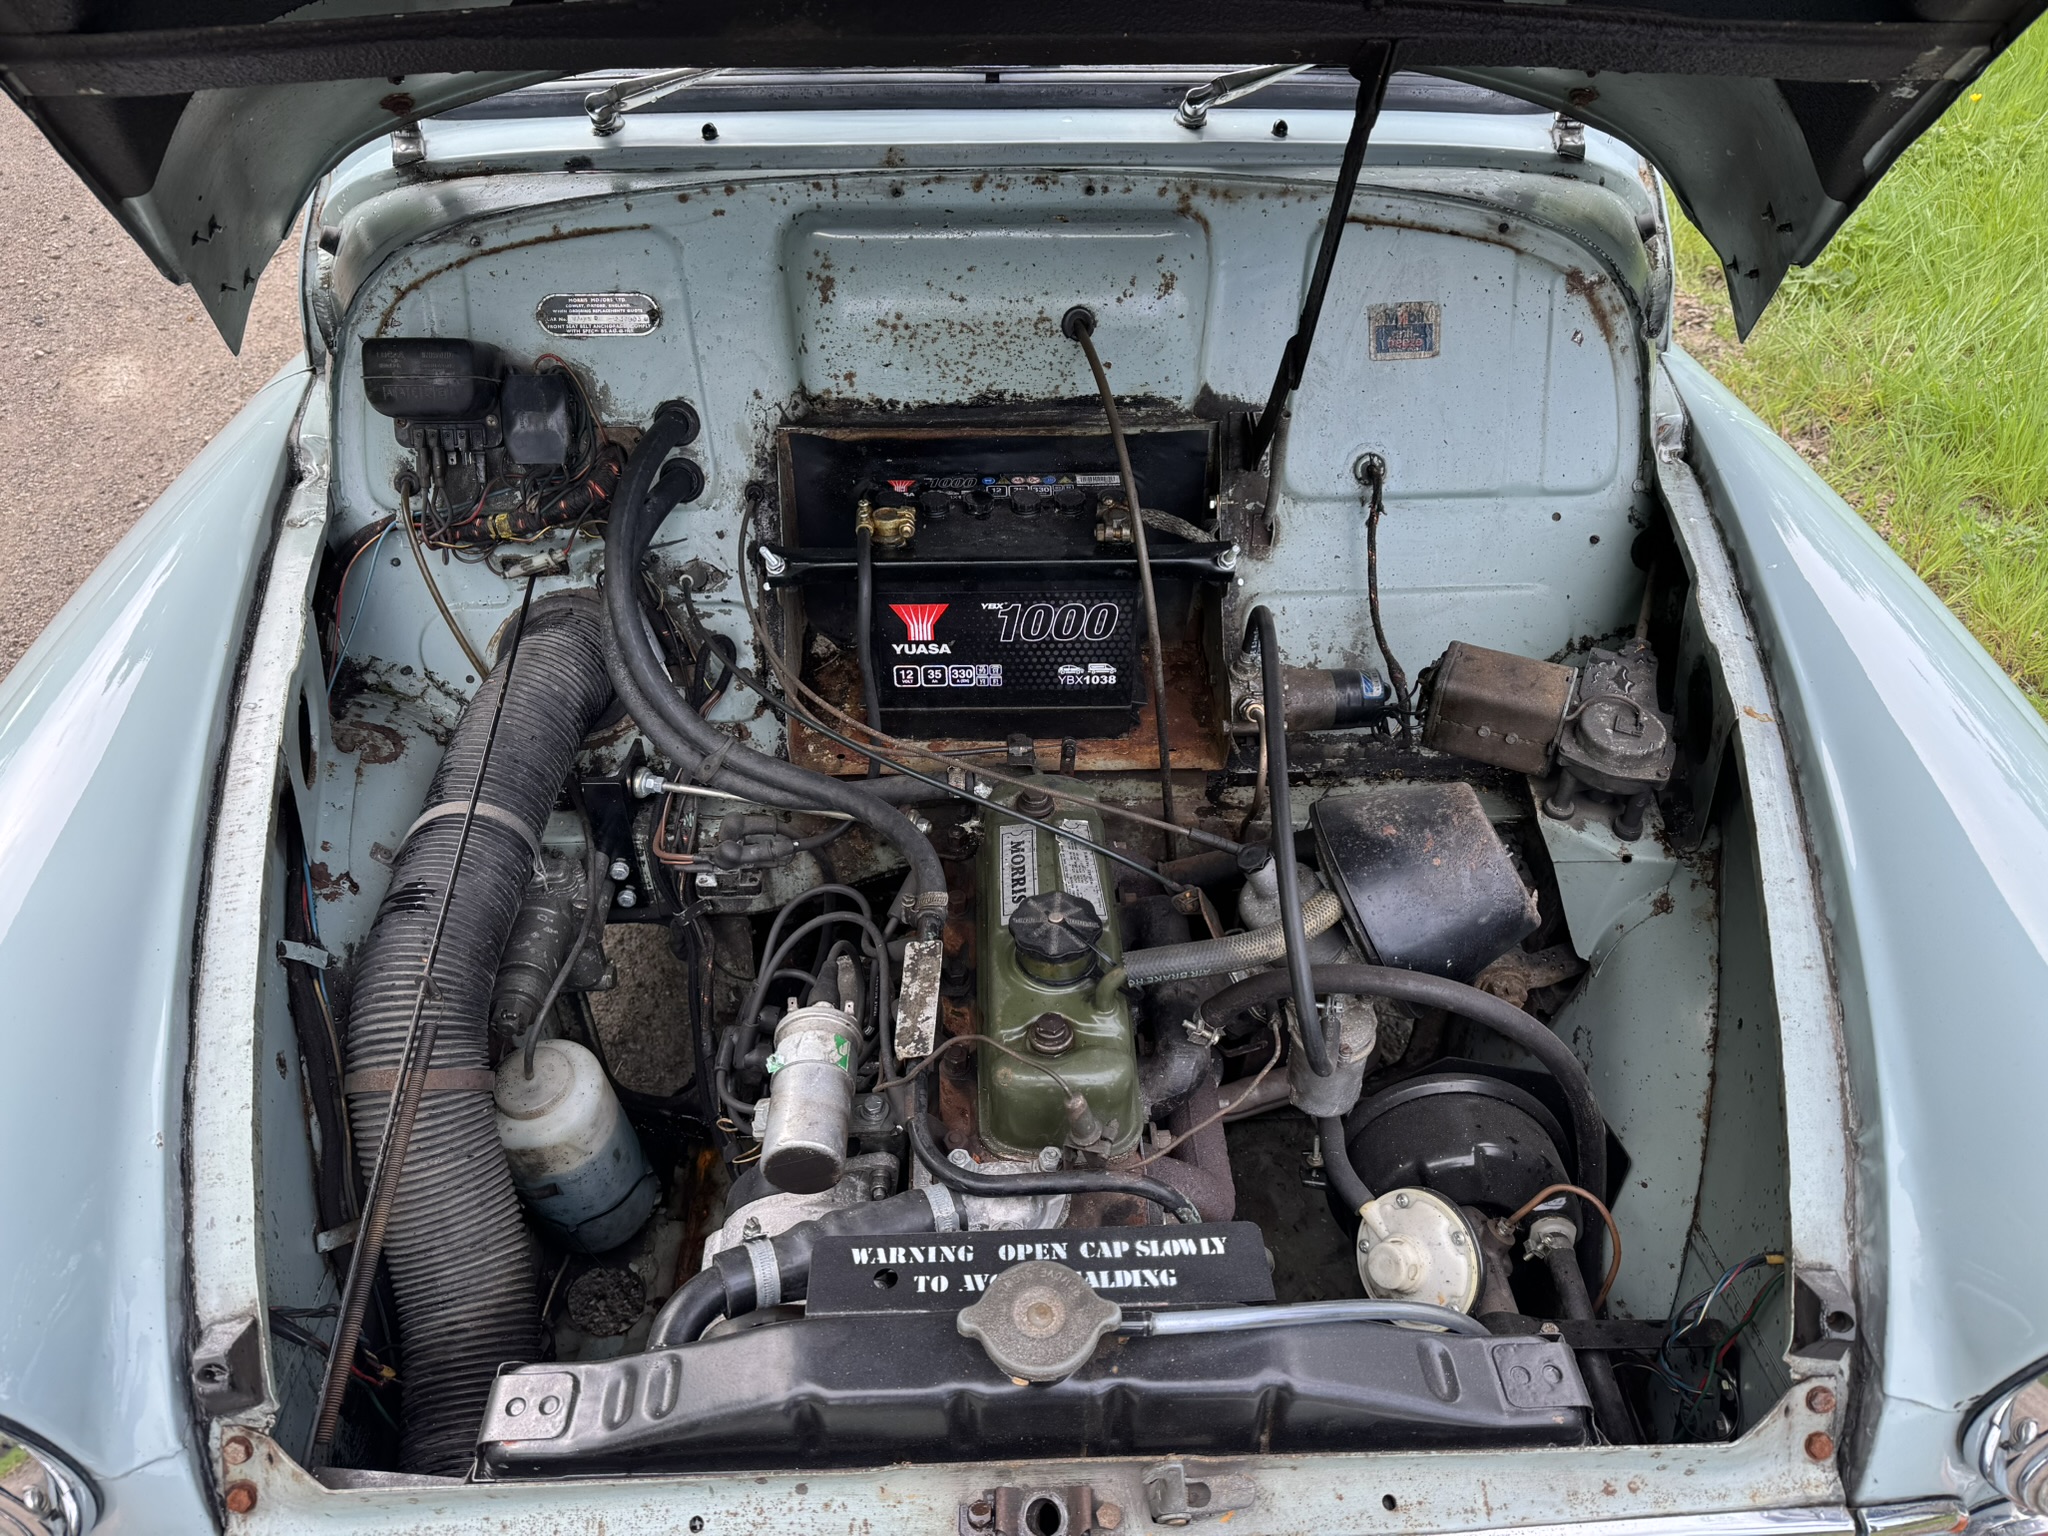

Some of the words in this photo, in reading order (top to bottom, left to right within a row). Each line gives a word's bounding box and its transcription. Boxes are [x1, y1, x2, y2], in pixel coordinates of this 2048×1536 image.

[930, 477, 977, 488] 1000
[998, 602, 1118, 642] 1000
[892, 644, 951, 654] YUASA
[900, 670, 914, 679] 12
[928, 670, 942, 678] 35
[952, 669, 972, 678] 330
[1058, 675, 1116, 684] YBX1038
[1010, 840, 1026, 904] MORRIS
[1147, 972, 1188, 984] BRAKE
[851, 1245, 974, 1264] WARNING
[998, 1242, 1068, 1261] OPEN
[1080, 1241, 1130, 1258] CAP
[1136, 1236, 1227, 1257] SLOWLY
[914, 1275, 949, 1293] TO
